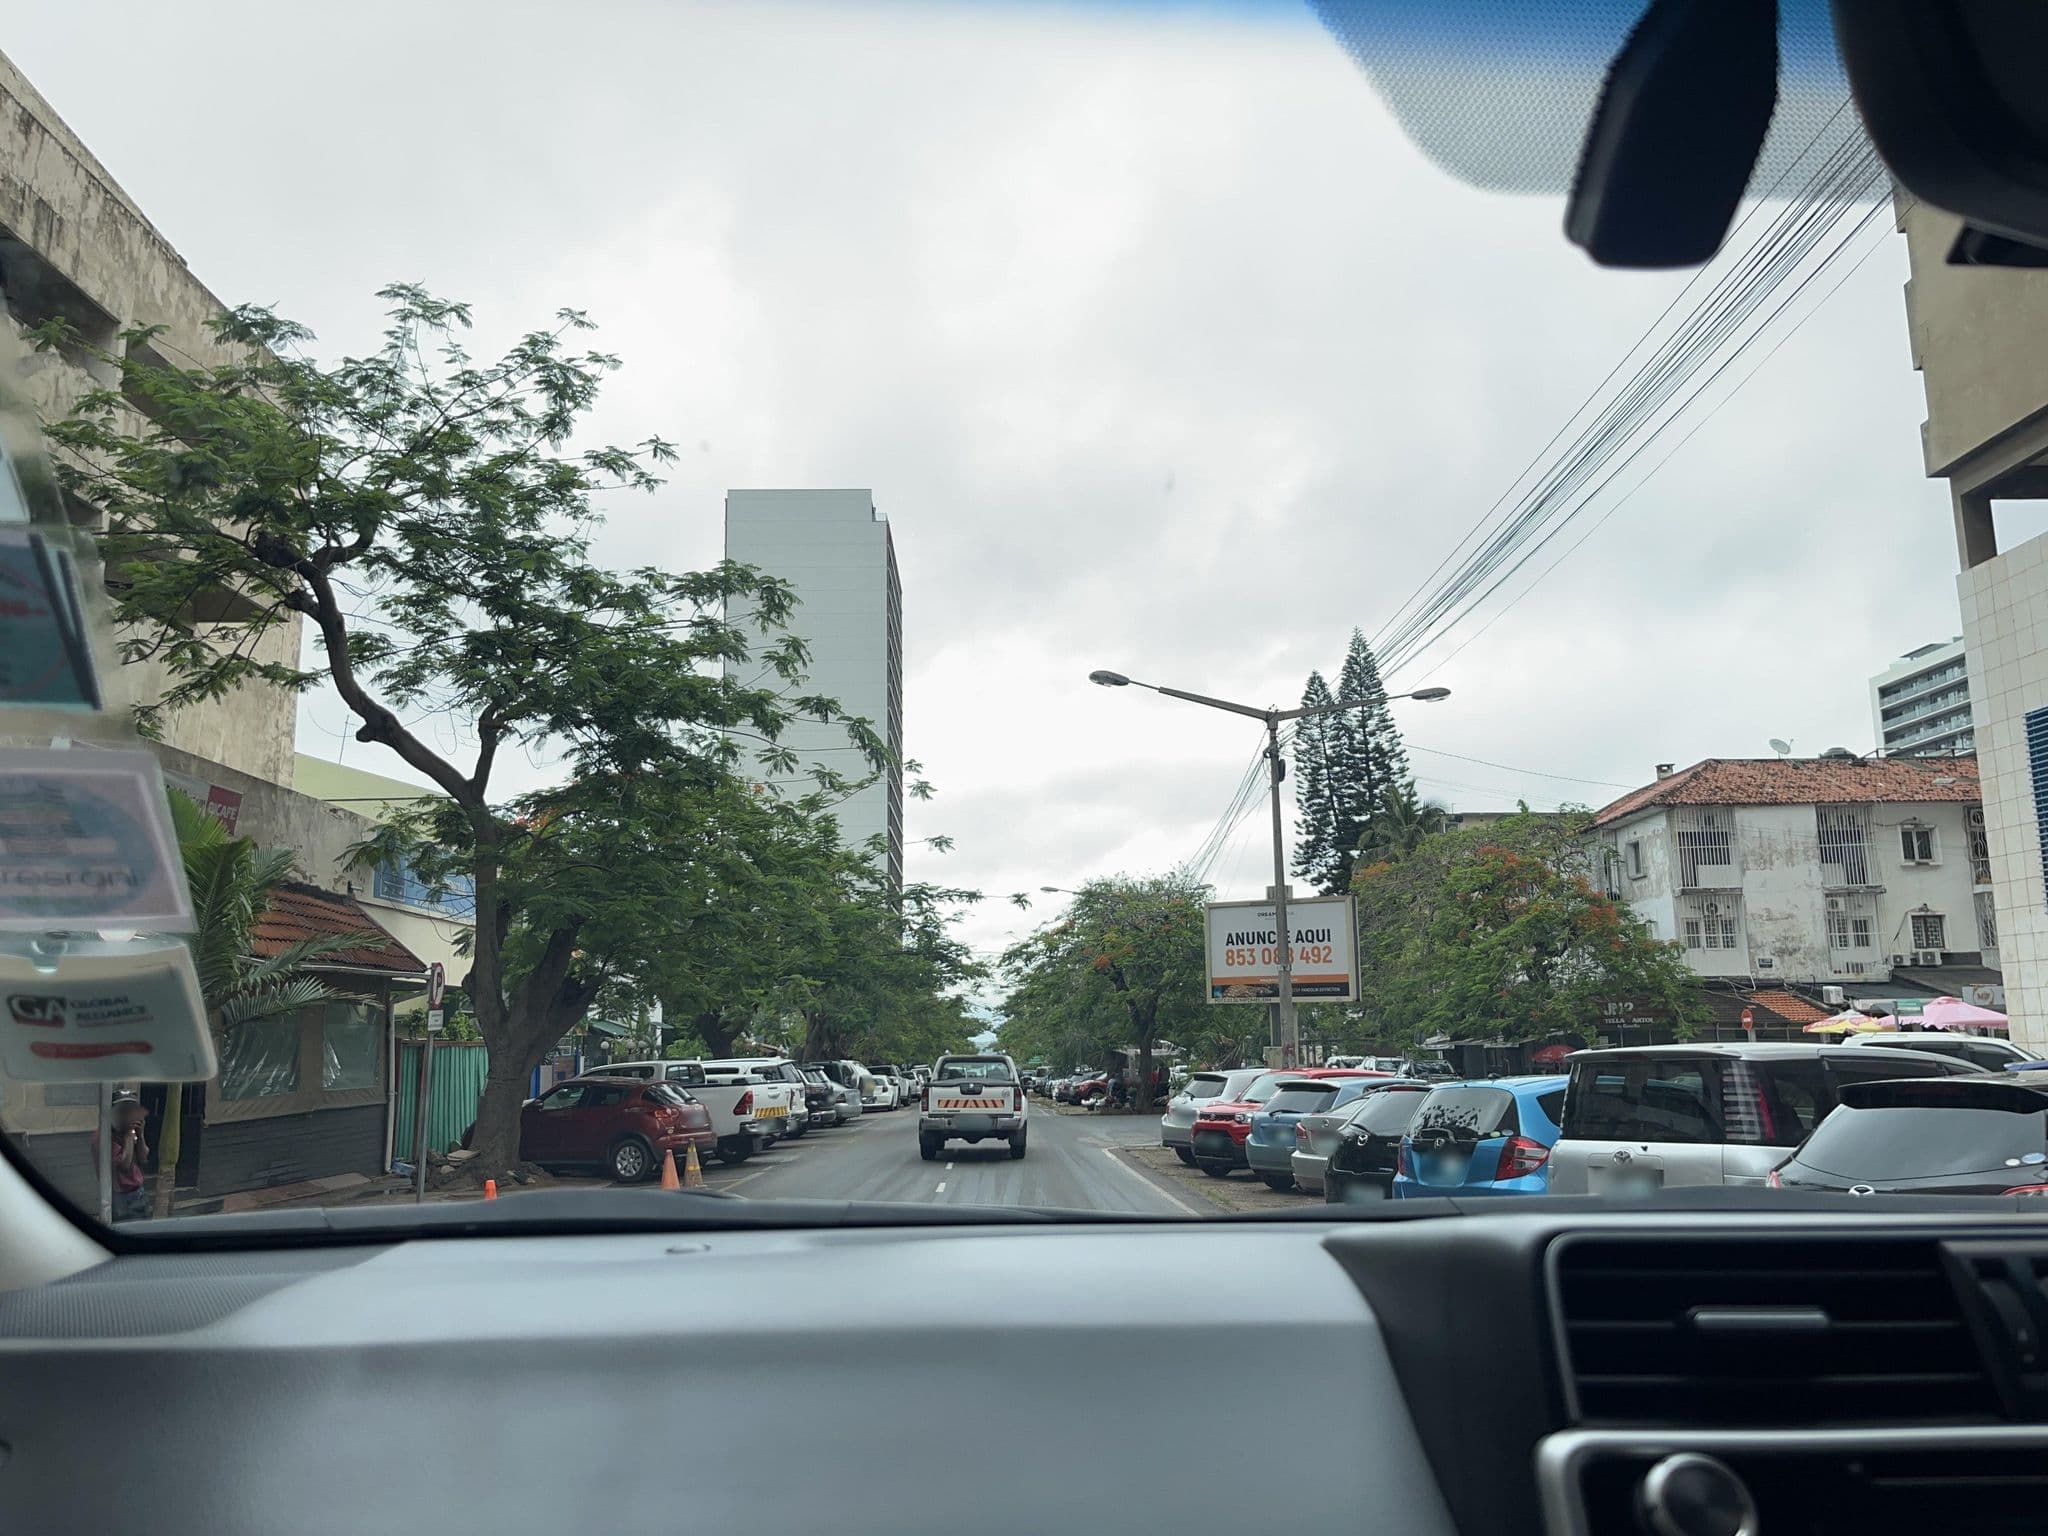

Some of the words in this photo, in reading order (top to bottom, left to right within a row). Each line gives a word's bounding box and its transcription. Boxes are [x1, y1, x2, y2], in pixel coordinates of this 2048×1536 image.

[1225, 930, 1290, 946] ANUNC
[1295, 928, 1331, 944] AQUI
[1225, 947, 1256, 967] 853
[1299, 945, 1333, 964] 492
